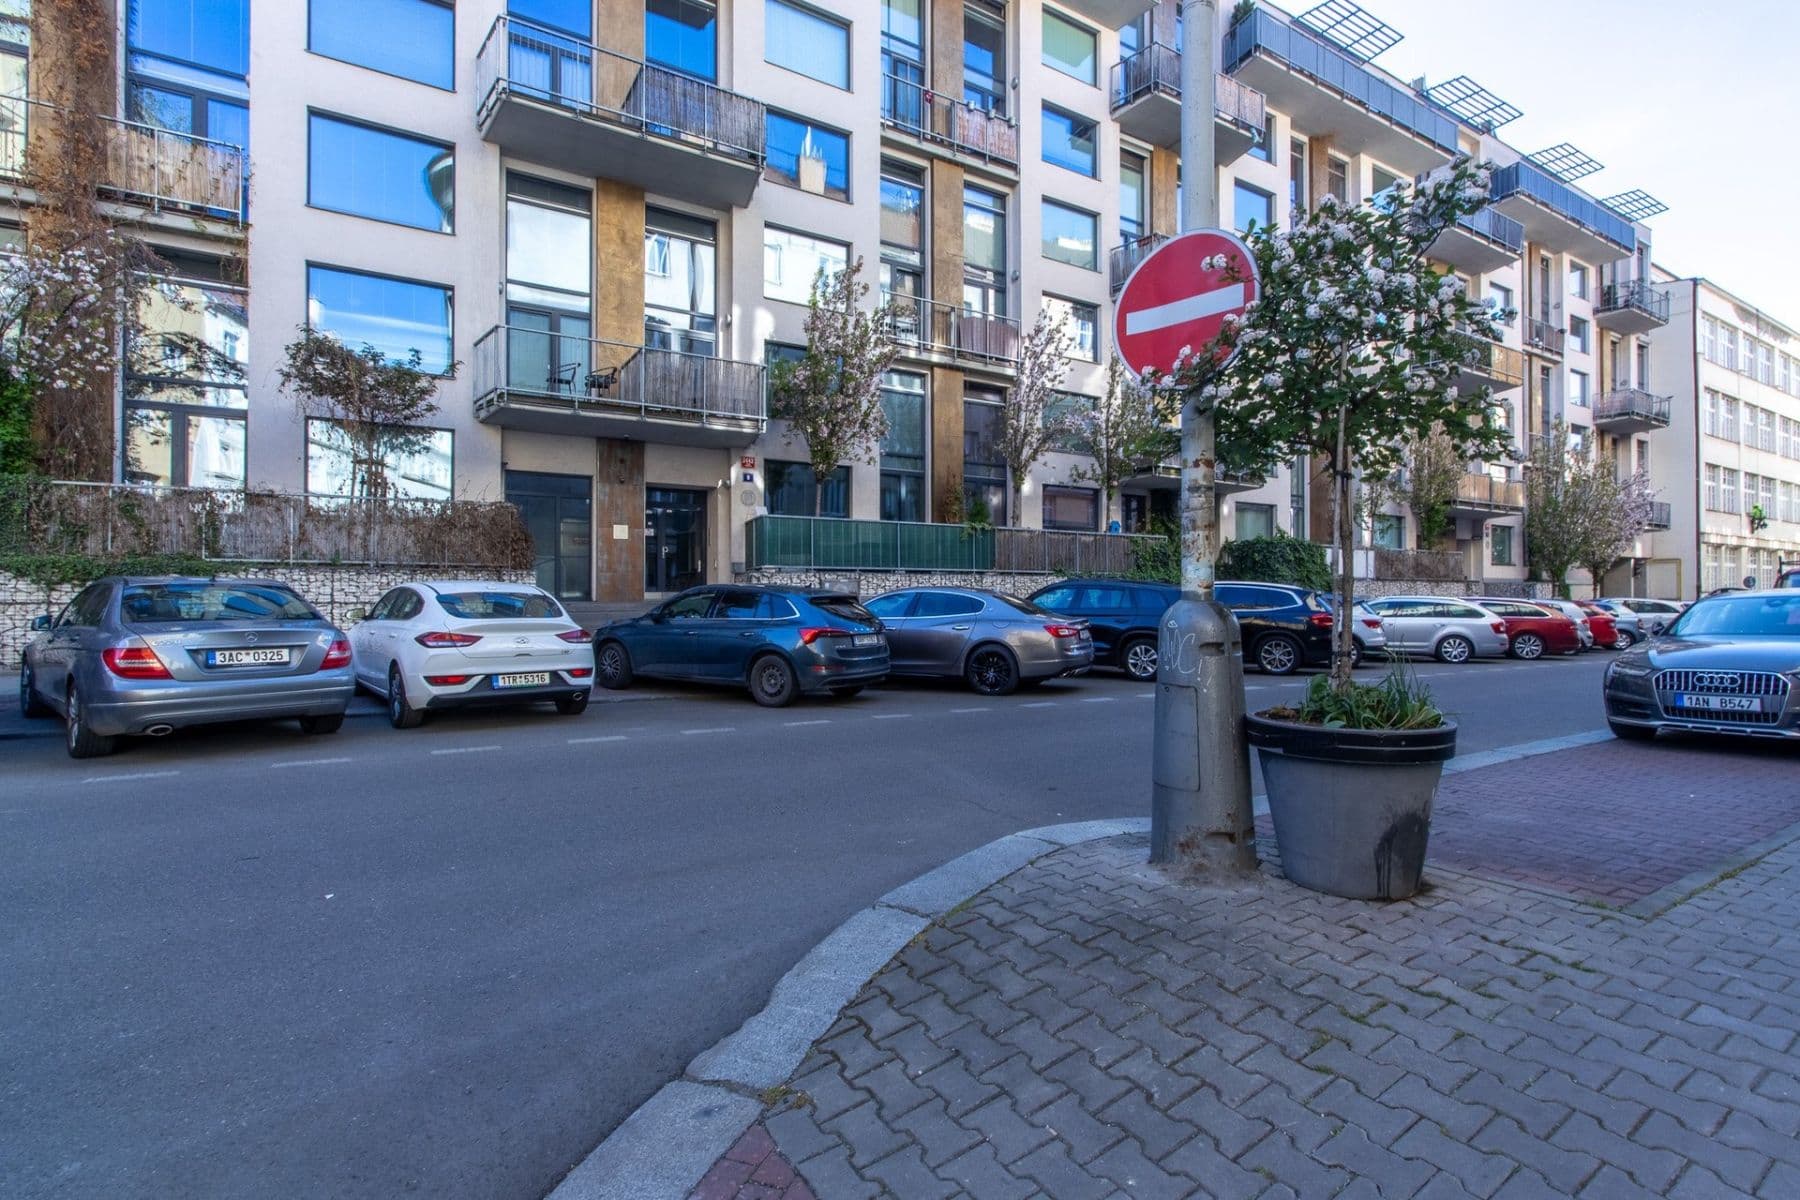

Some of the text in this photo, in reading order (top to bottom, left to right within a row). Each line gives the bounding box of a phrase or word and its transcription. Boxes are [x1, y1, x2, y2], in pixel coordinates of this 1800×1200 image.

[219, 650, 284, 663] 3AC 0325
[524, 673, 546, 684] 5316
[1687, 696, 1710, 707] 1AN
